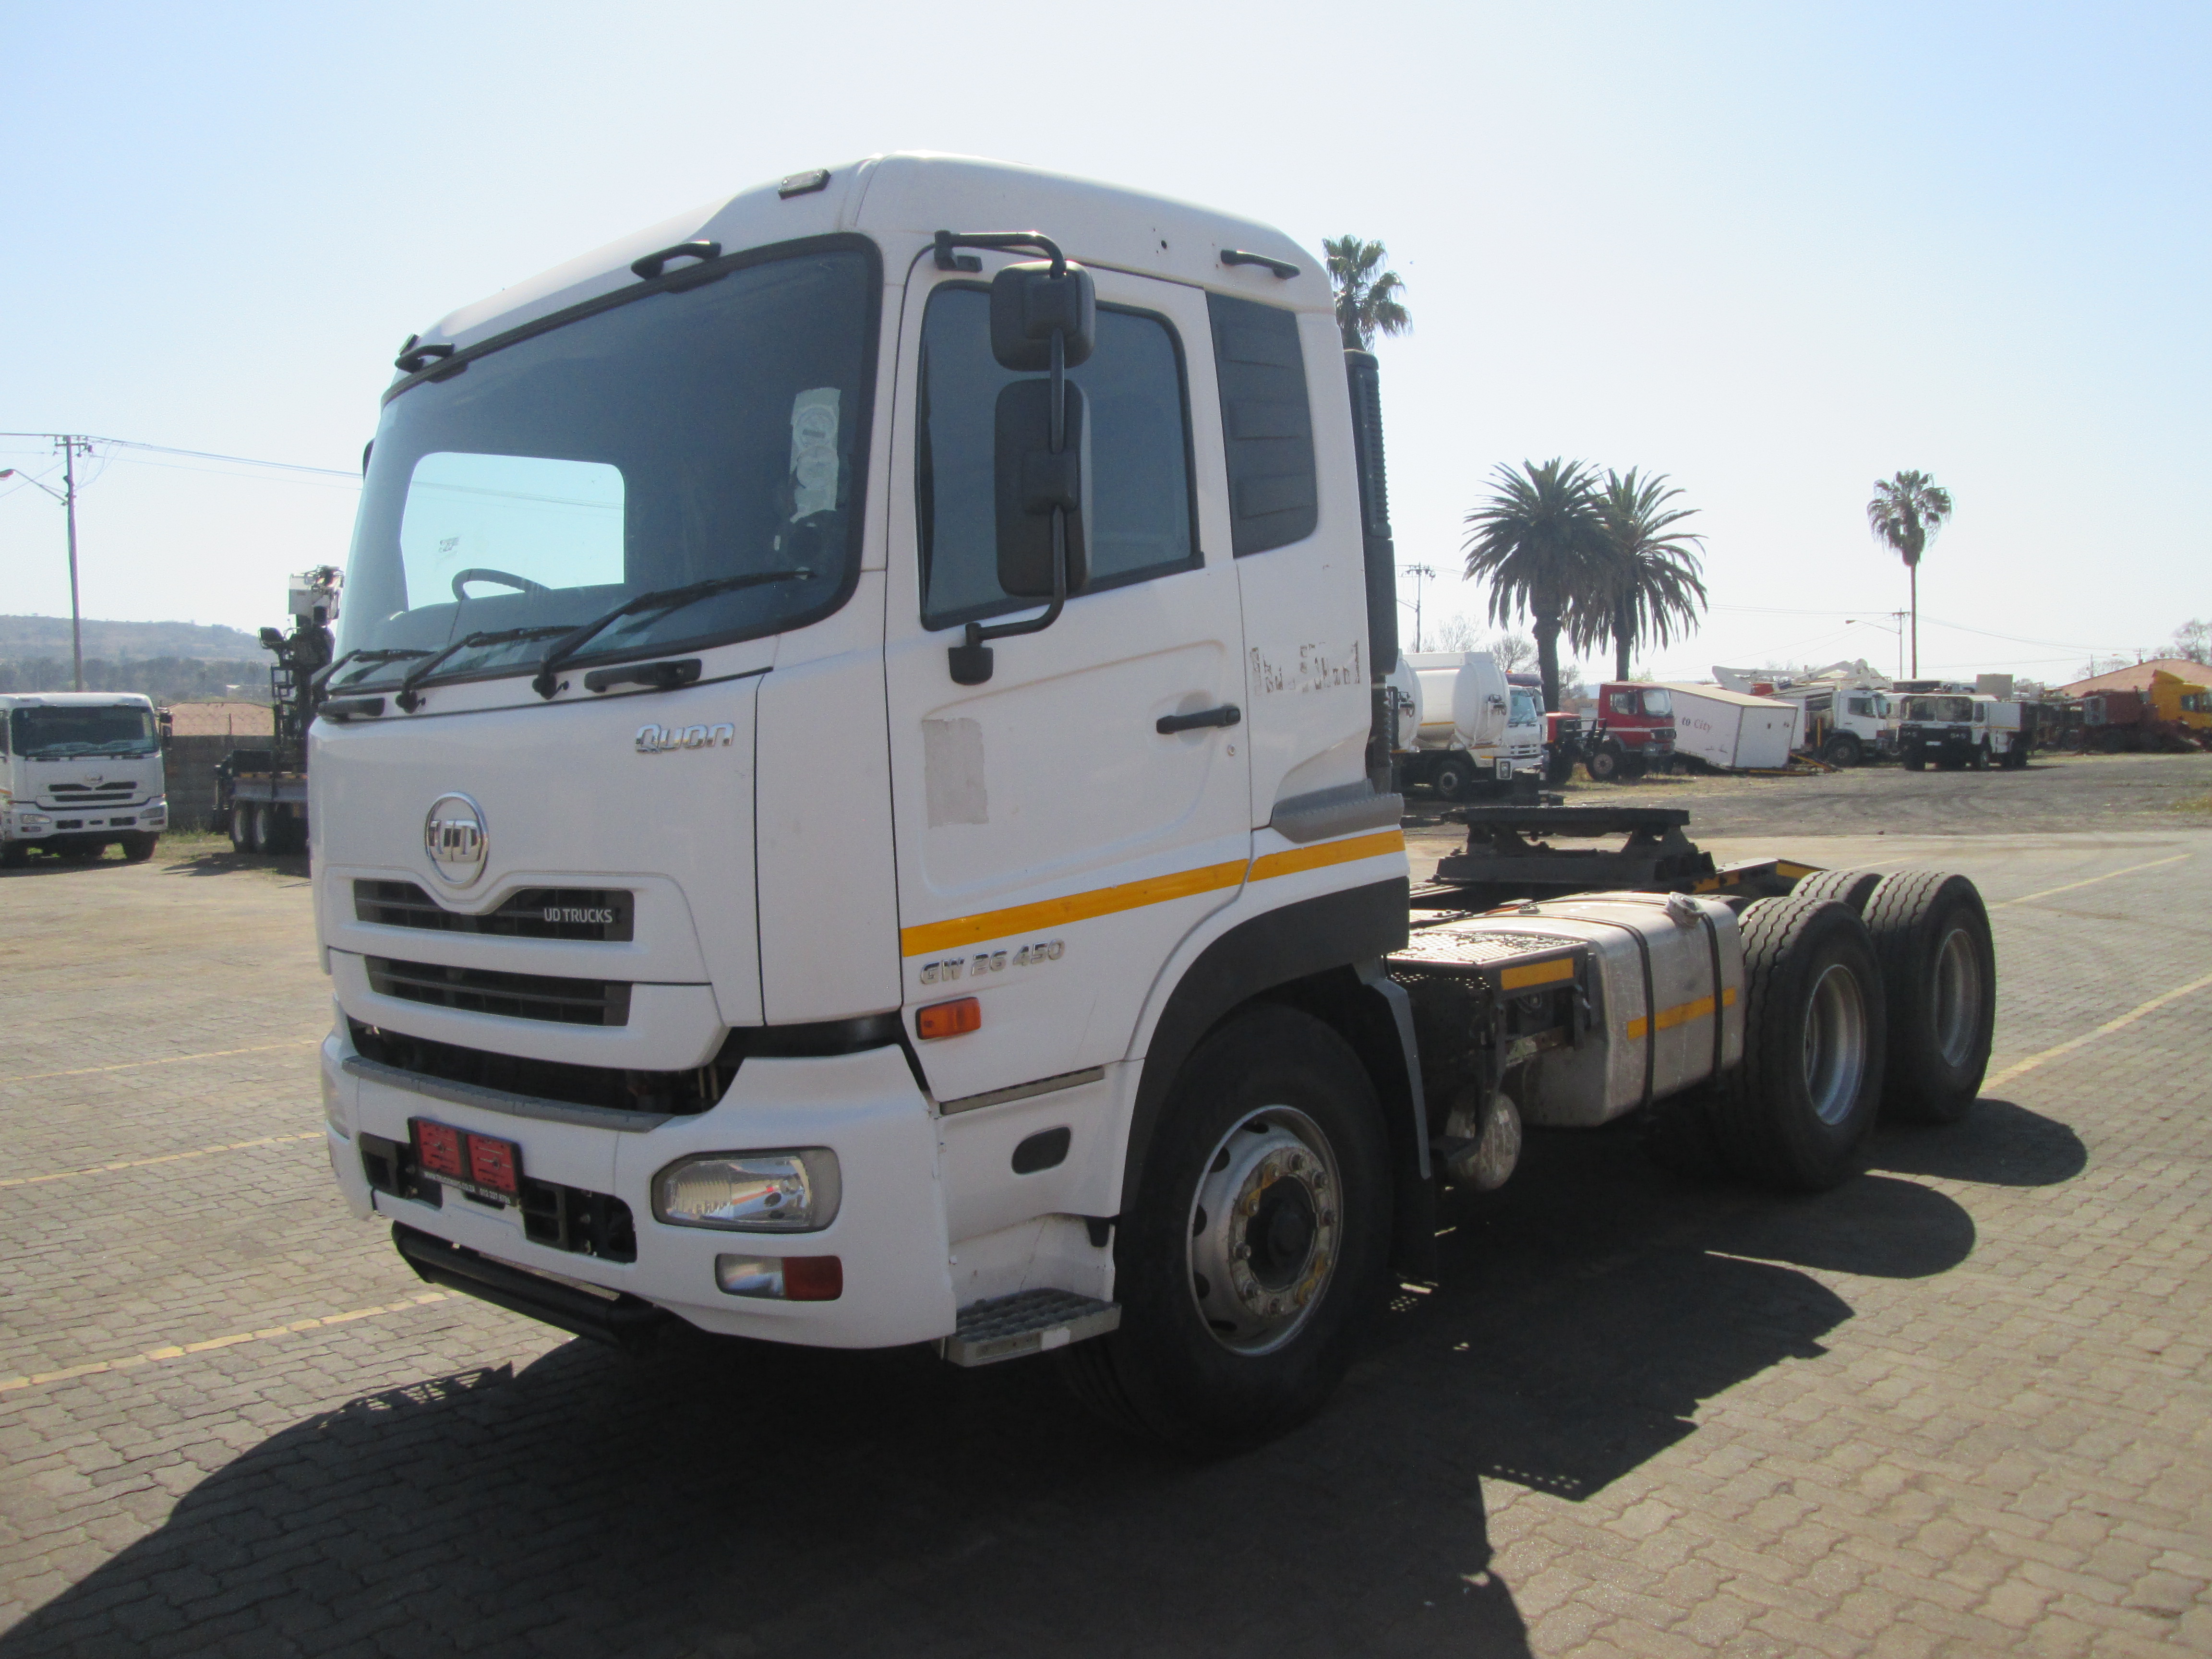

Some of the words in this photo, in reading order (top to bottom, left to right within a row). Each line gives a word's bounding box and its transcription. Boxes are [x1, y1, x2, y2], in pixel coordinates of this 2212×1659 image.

[635, 723, 735, 753] Quon
[1682, 717, 1691, 726] to
[1694, 719, 1712, 733] City
[429, 820, 481, 862] UD
[544, 907, 561, 922] UD
[562, 909, 613, 923] TRUCKS
[921, 958, 965, 985] GW
[971, 949, 1008, 976] 26
[1013, 938, 1065, 967] 450
